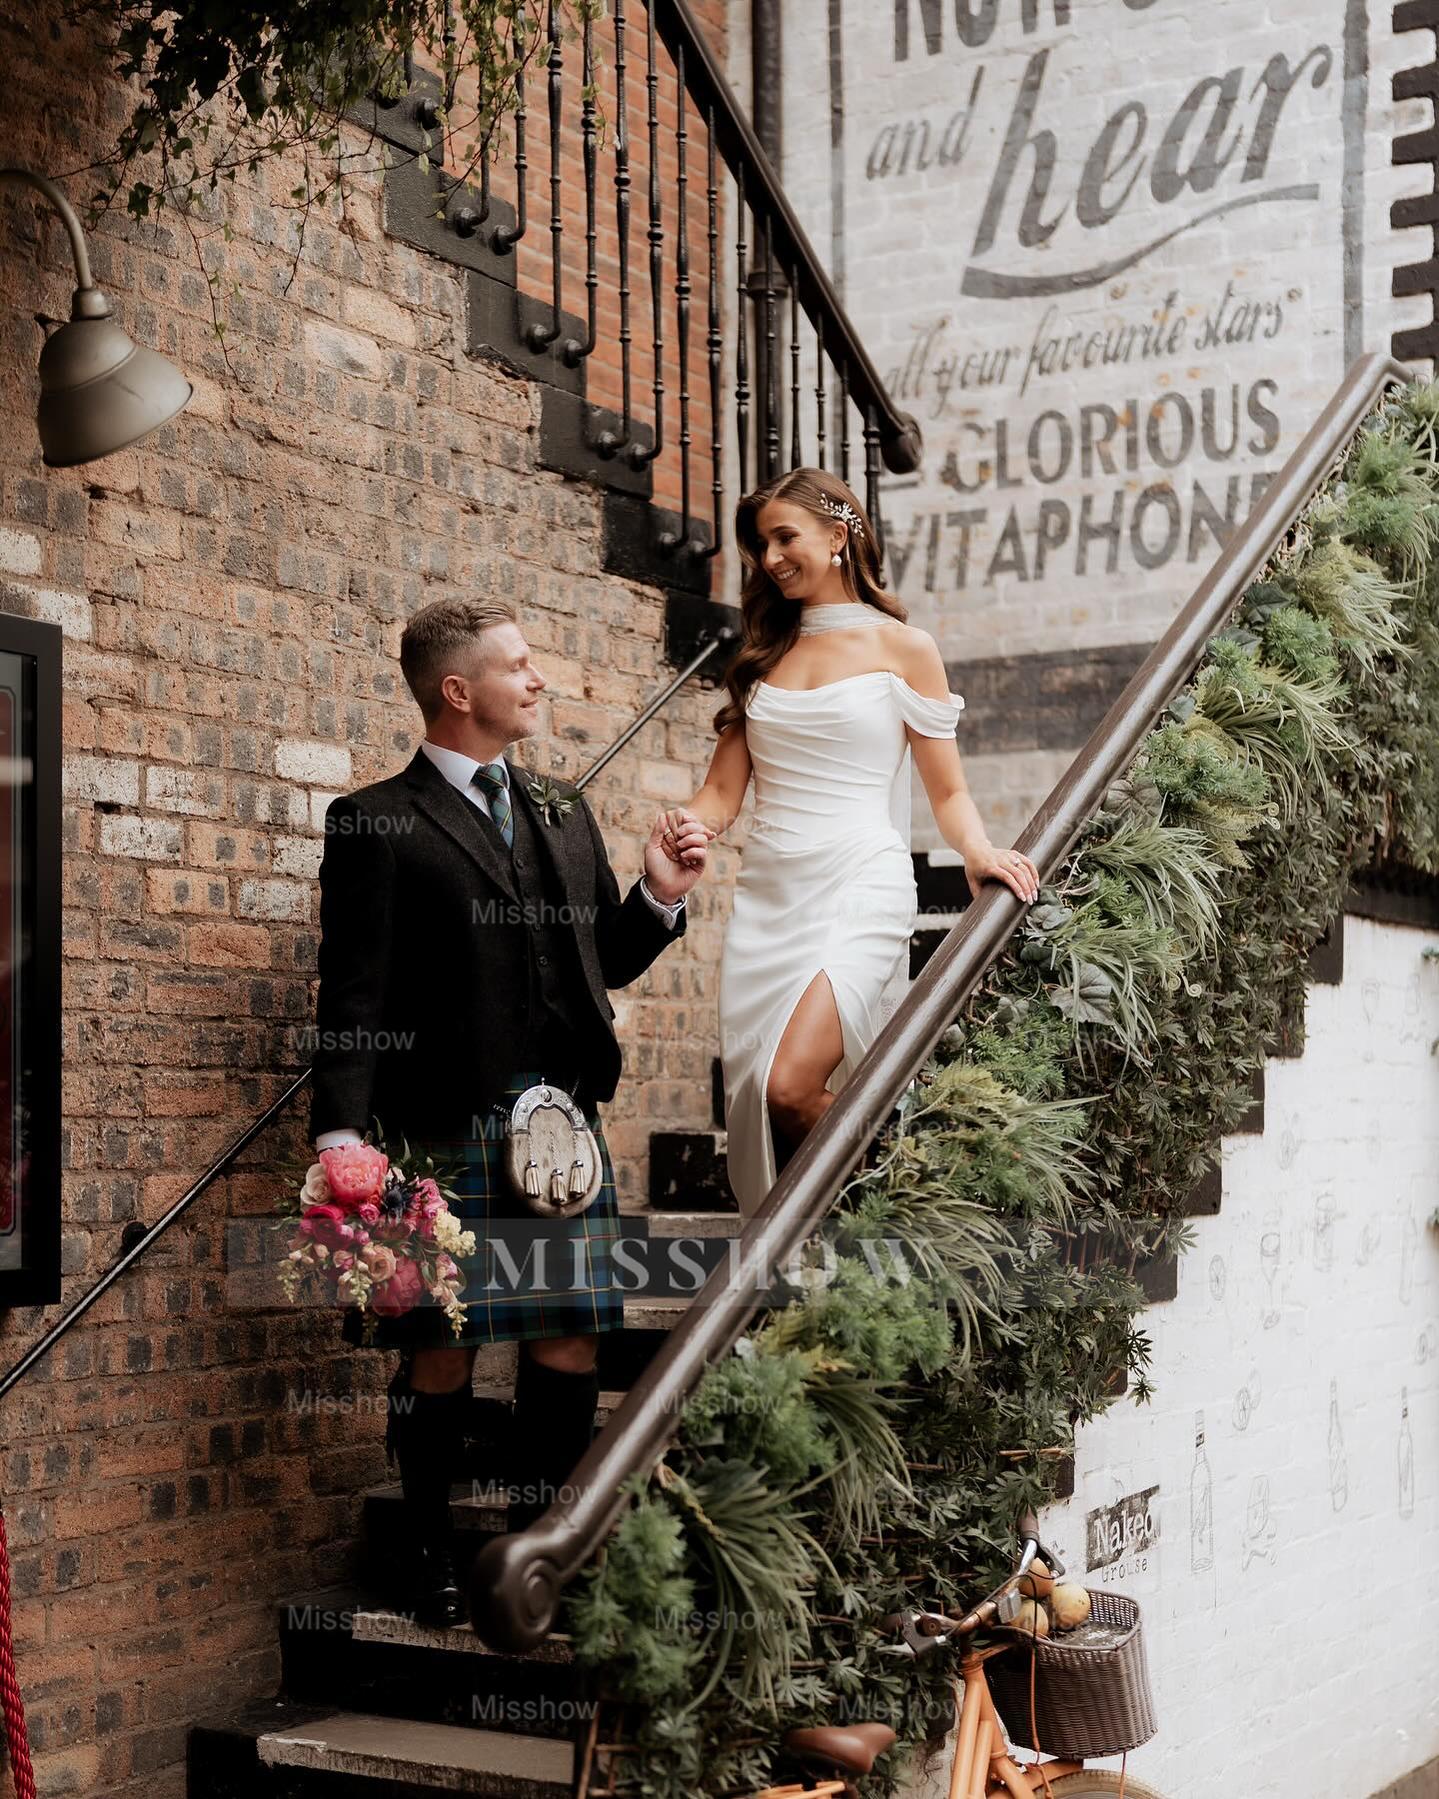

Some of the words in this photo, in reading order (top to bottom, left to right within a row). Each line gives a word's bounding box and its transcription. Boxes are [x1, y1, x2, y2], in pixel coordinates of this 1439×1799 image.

[866, 65, 985, 181] and
[971, 44, 1333, 258] hear
[931, 347, 1021, 418] your
[1020, 289, 1188, 396] favourite
[1194, 279, 1284, 351] stars
[943, 378, 1281, 494] GLORIOUS
